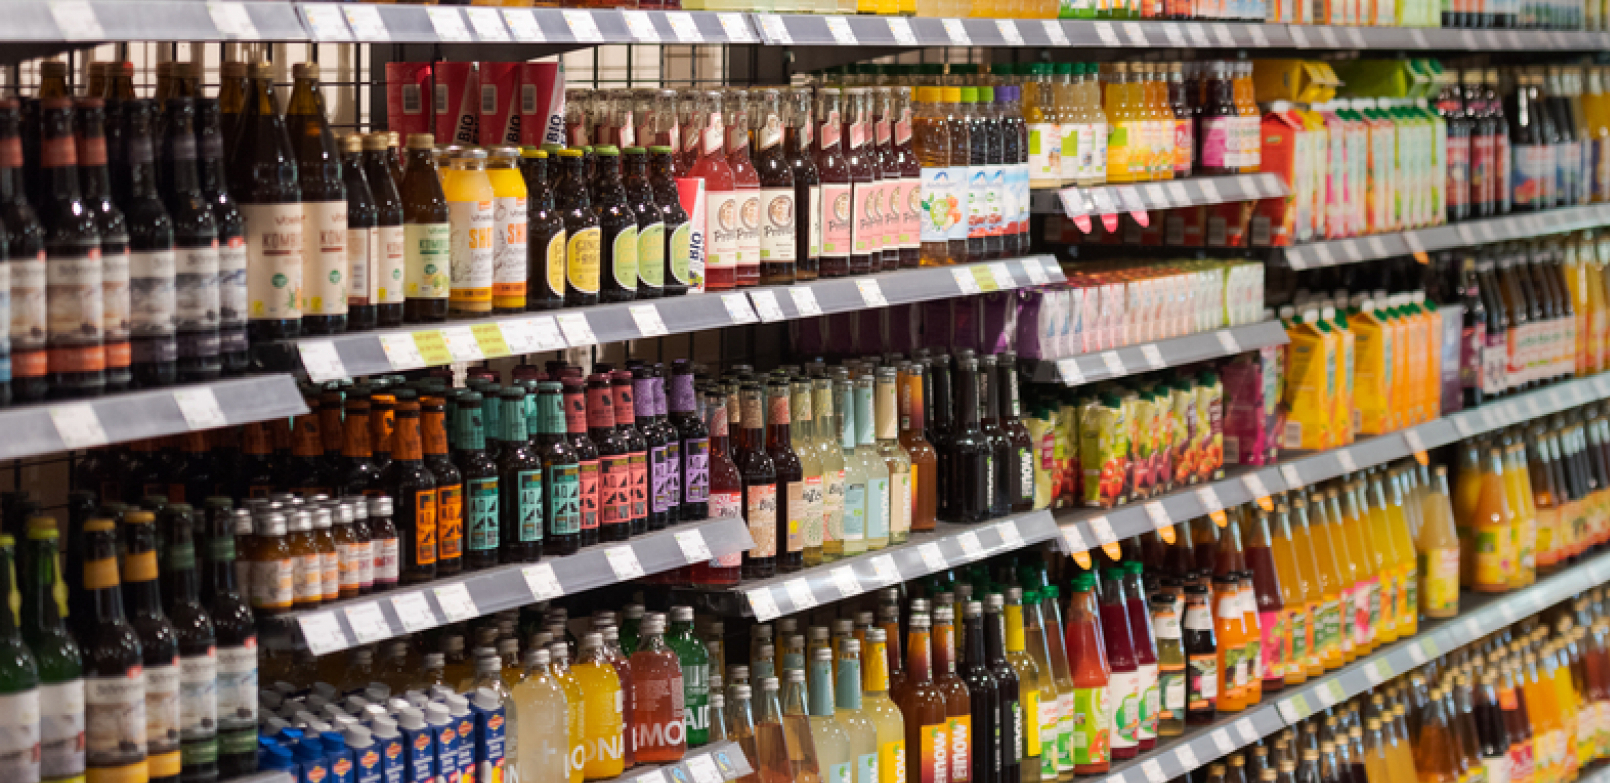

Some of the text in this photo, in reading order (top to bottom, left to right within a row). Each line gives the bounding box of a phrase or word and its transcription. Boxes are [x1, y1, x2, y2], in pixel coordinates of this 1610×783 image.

[457, 114, 474, 142] BIO
[507, 114, 521, 142] BIO
[689, 231, 703, 260] BIO
